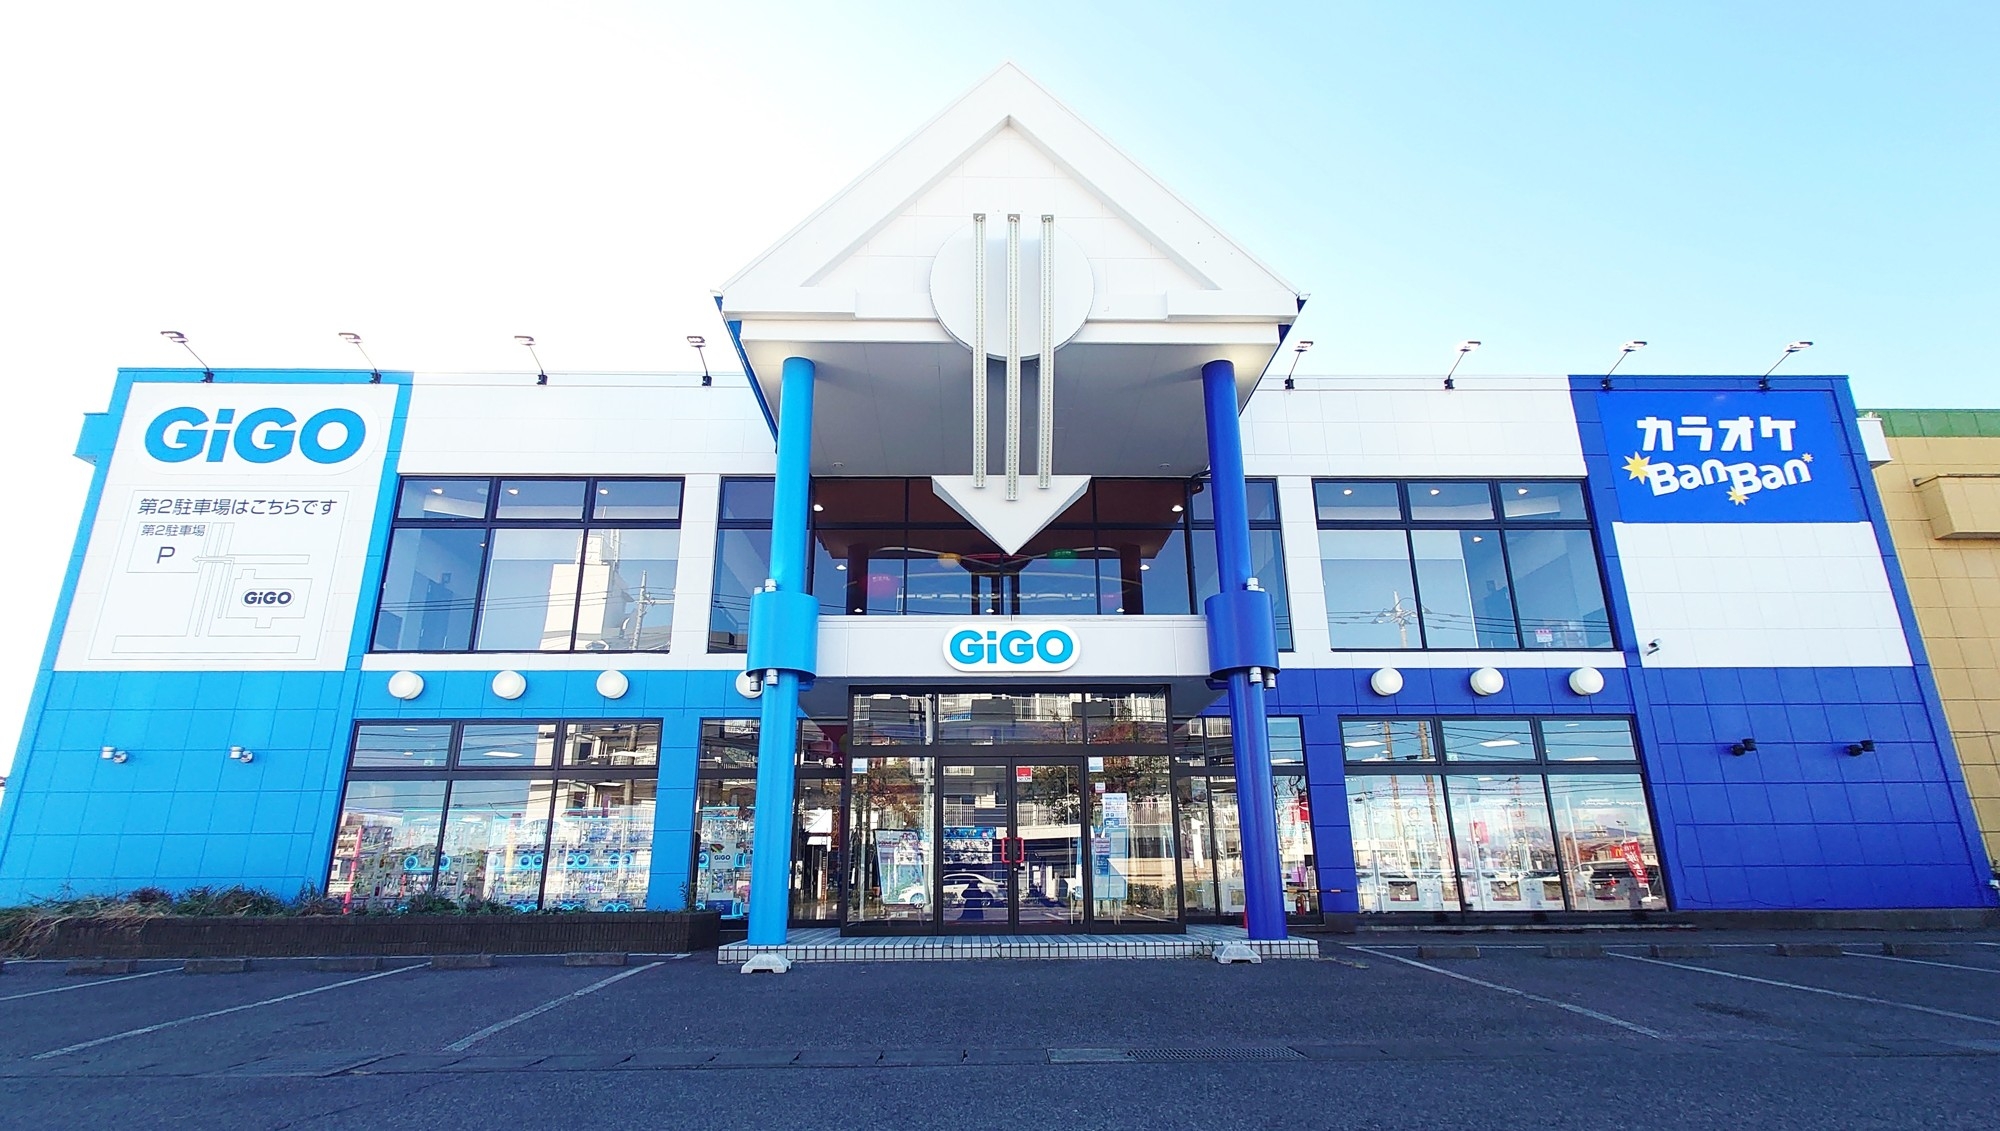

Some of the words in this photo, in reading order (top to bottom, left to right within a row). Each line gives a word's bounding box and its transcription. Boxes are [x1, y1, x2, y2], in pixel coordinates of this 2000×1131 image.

[145, 406, 366, 464] GiGO
[1636, 416, 1797, 452] カラオケ
[1647, 458, 1812, 497] BanBan
[137, 498, 338, 516] 第2駐車場はこちらです
[140, 524, 206, 537] 第2駐車場
[156, 546, 176, 564] P
[243, 591, 292, 605] GiGO
[949, 629, 1074, 665] GiGO
